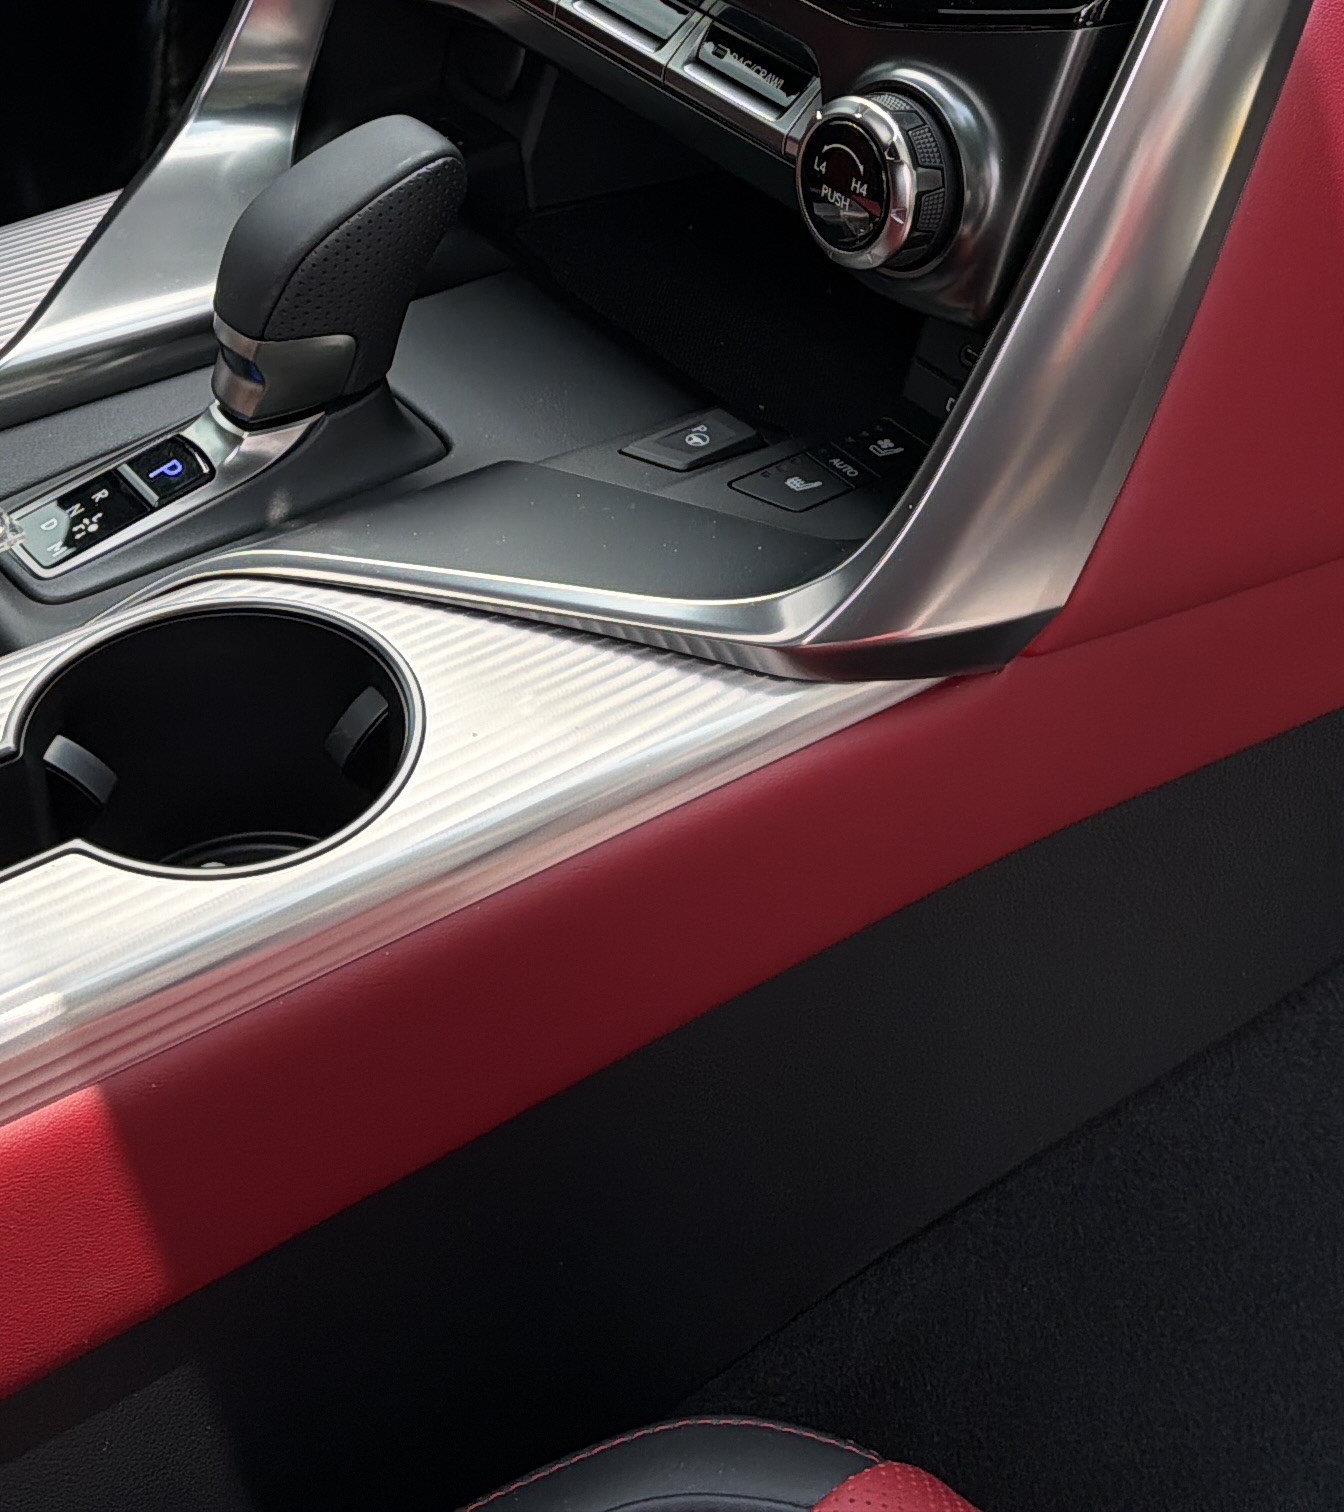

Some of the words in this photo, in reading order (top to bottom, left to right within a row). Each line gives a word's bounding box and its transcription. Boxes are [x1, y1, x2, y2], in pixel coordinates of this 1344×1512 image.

[814, 155, 827, 175] L4
[821, 183, 850, 211] PUSH
[850, 177, 868, 197] H4
[148, 458, 183, 479] P
[828, 458, 859, 478] AUTO
[91, 488, 109, 502] R
[65, 503, 85, 518] N
[40, 518, 58, 531] D
[46, 540, 68, 558] M
